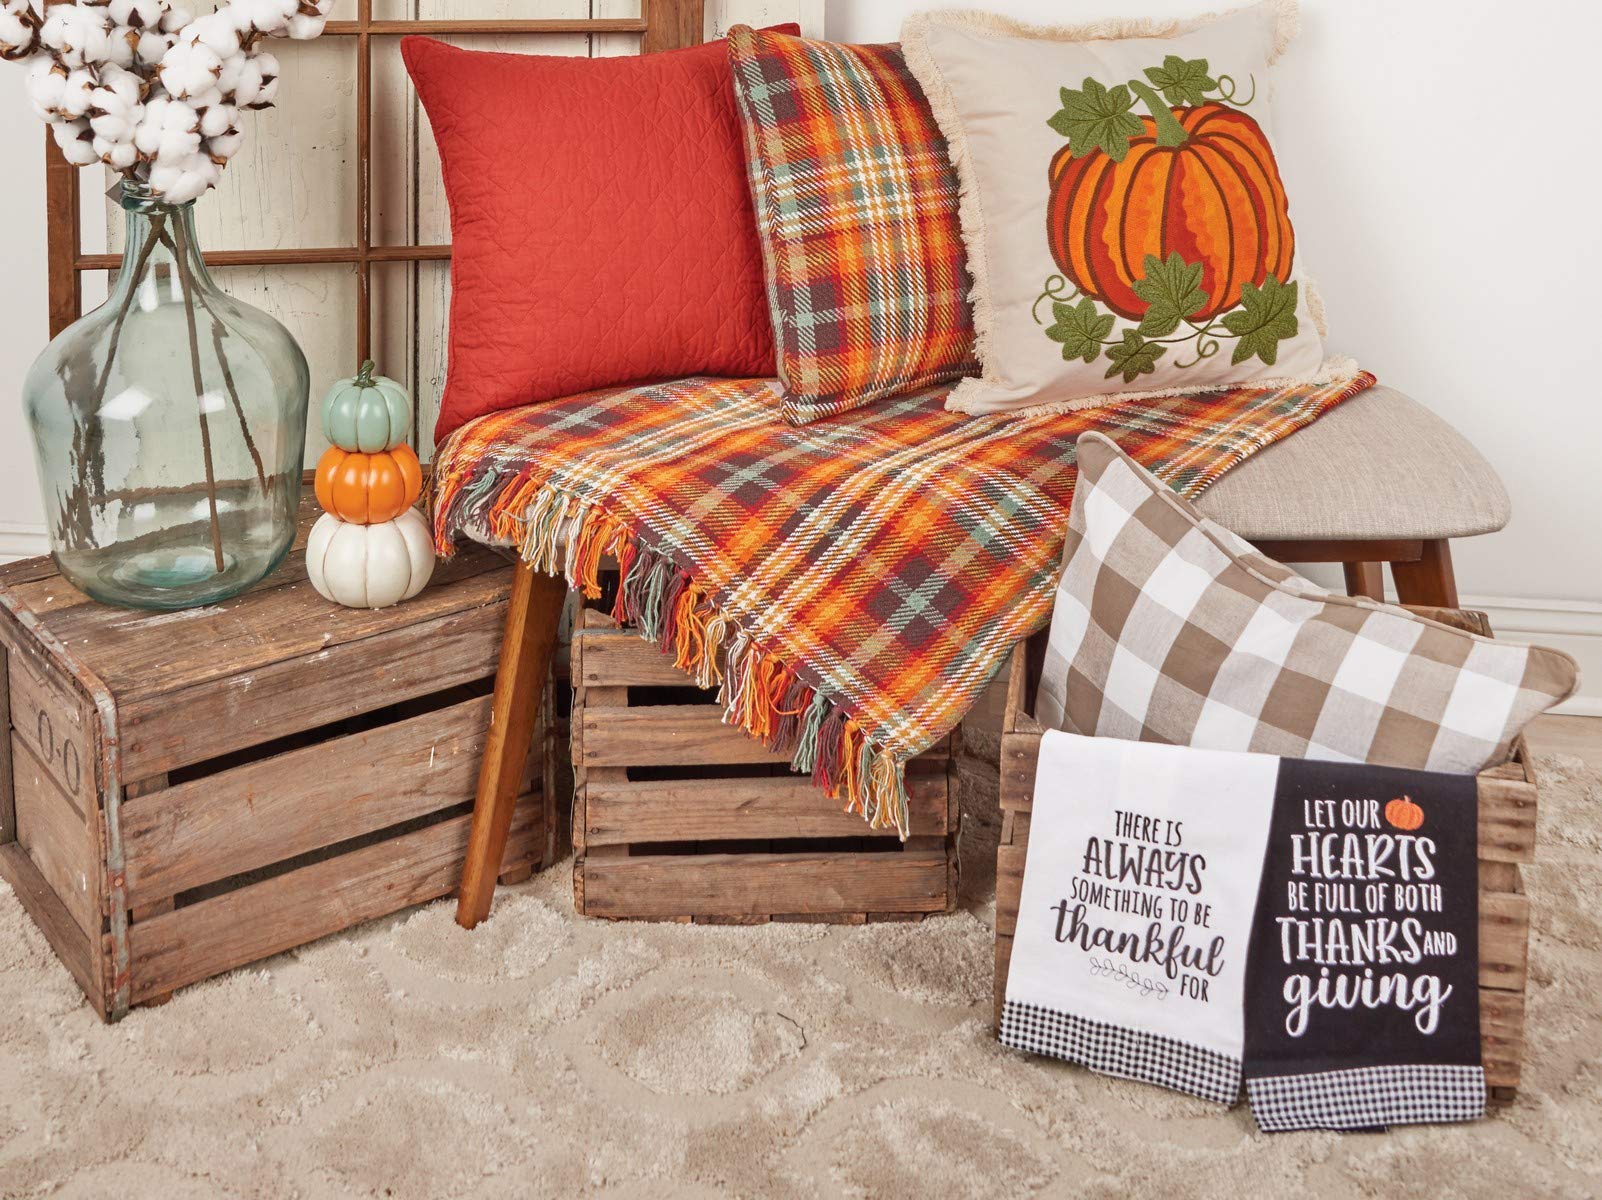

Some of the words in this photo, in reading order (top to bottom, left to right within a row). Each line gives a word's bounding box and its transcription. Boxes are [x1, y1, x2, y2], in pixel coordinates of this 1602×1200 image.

[1115, 810, 1161, 844] THERE
[1164, 820, 1183, 847] IS
[1303, 799, 1336, 829] LET
[1341, 799, 1381, 829] OUR
[1082, 836, 1206, 895] ALWAYS
[1290, 832, 1436, 881] HEARTS
[1070, 877, 1163, 919] SOMETHING
[1170, 897, 1188, 923] TO
[1194, 902, 1212, 928] BE
[1288, 881, 1309, 912] BE
[1314, 882, 1361, 913] FULL
[1365, 882, 1389, 914] OF
[1394, 883, 1443, 912] BOTH
[1050, 899, 1225, 980] thankful
[1275, 917, 1422, 965] THANKS
[1423, 931, 1457, 956] AND
[1180, 974, 1209, 1002] FOR
[1283, 966, 1453, 1038] giving
